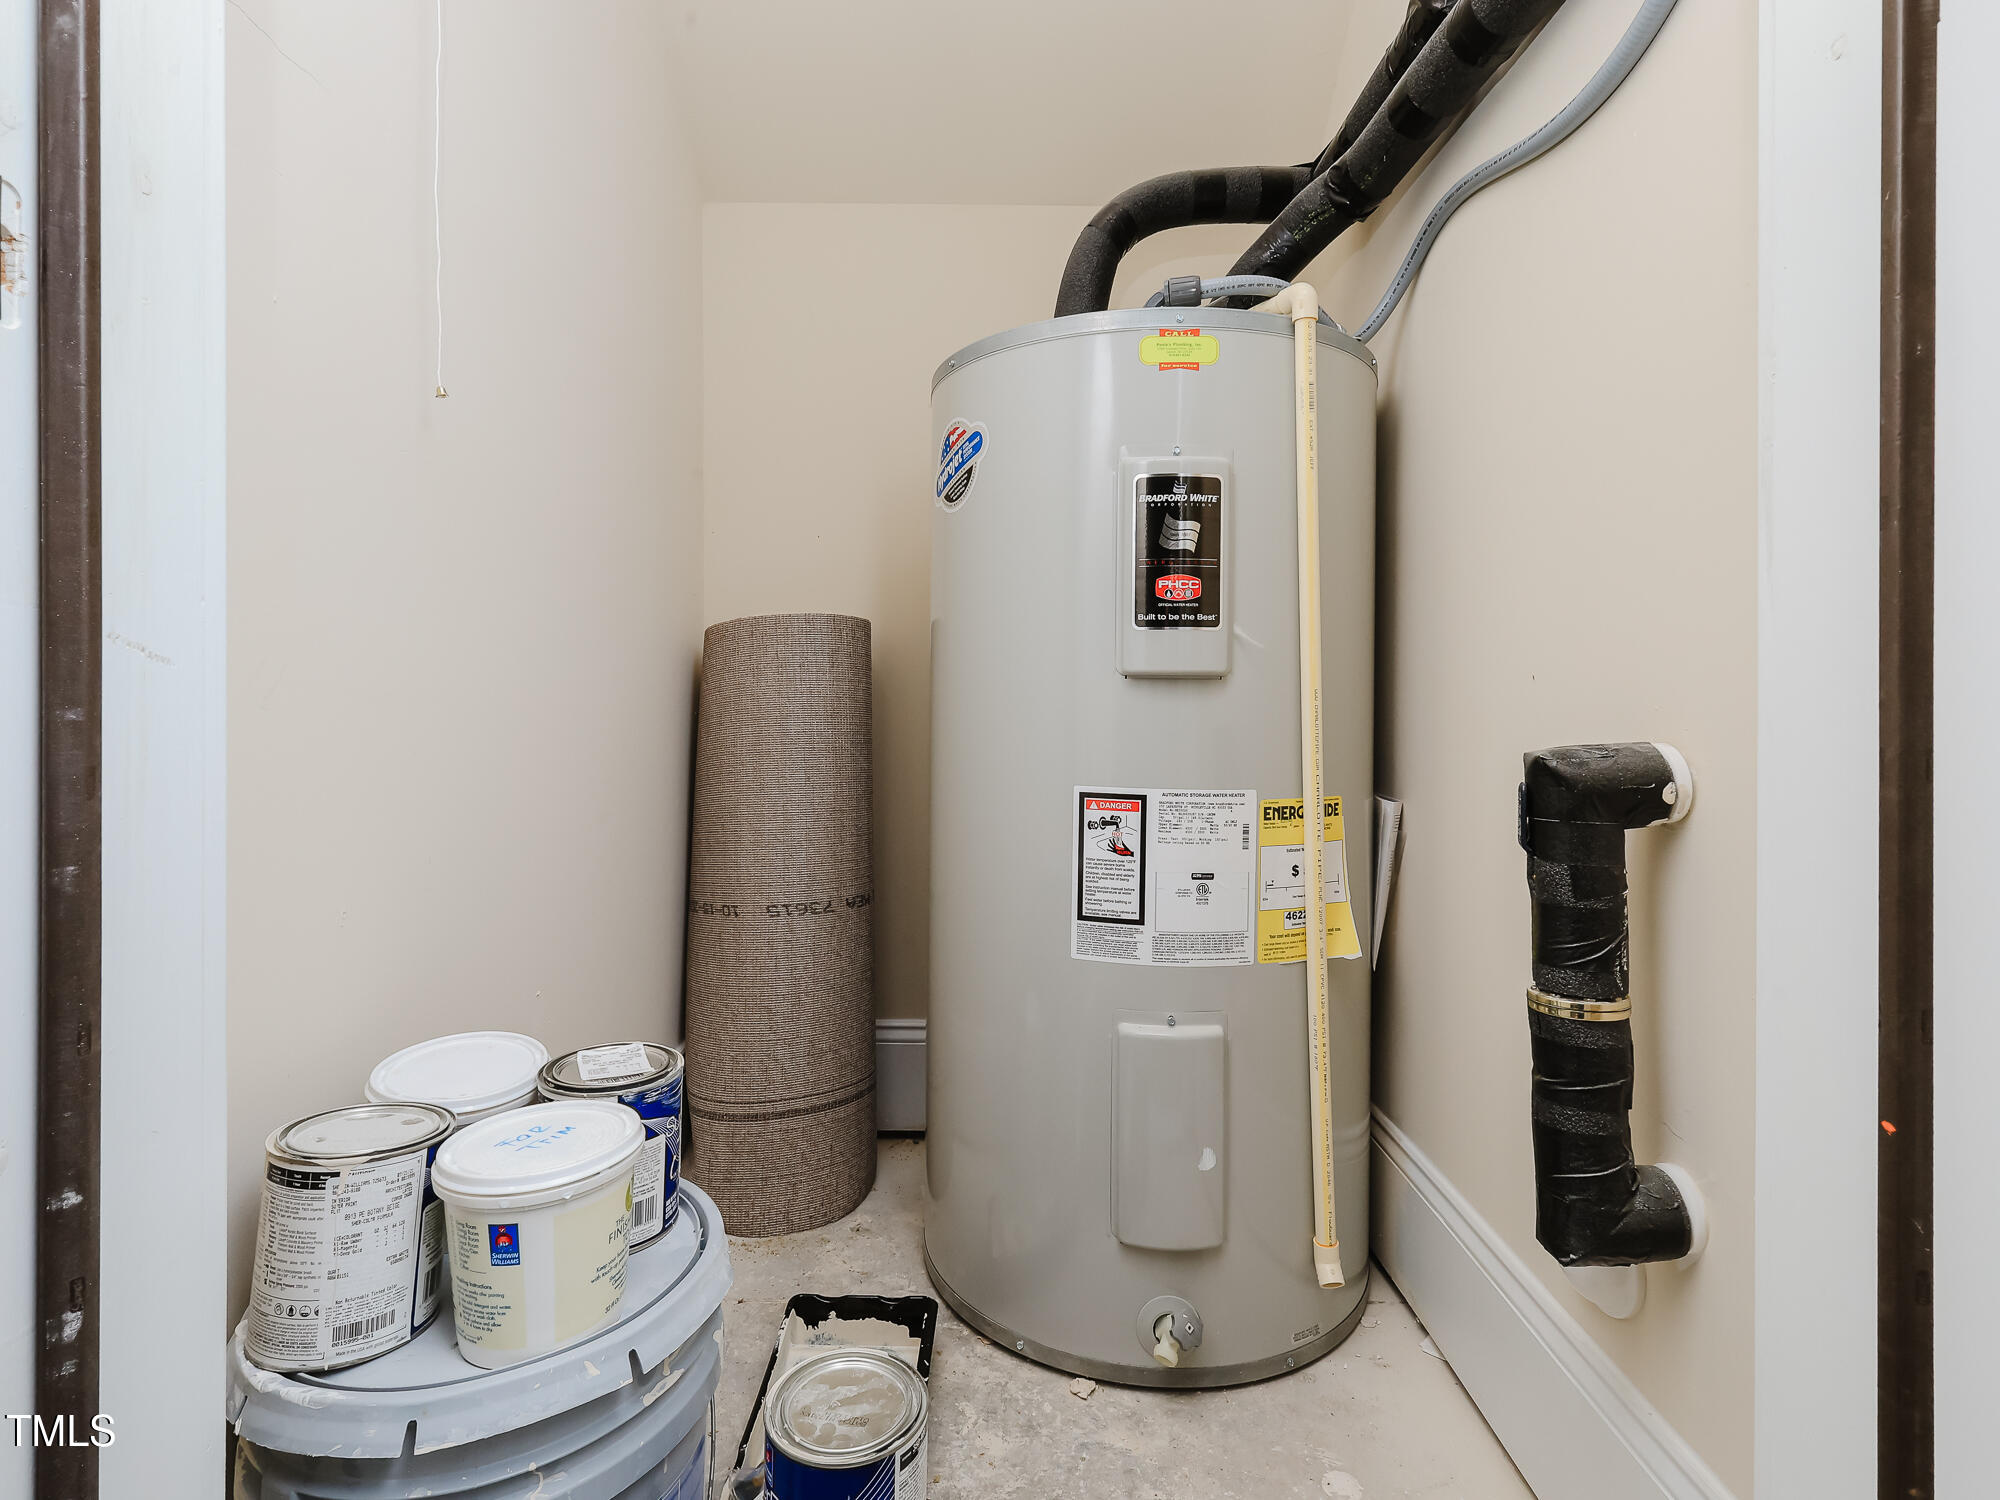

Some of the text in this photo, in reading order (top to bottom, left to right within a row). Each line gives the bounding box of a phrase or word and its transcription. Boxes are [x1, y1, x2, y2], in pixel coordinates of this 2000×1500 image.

[1139, 494, 1218, 503] BRADFORD WHITE
[1158, 580, 1199, 588] PHCC
[1138, 613, 1156, 621] Built
[1168, 613, 1179, 621] be
[1182, 613, 1195, 621] the
[1100, 802, 1132, 810] DANGER
[1291, 865, 1299, 877] $
[332, 1180, 371, 1190] SHEIN-WILLIAMS
[367, 1207, 384, 1216] BOTANY
[386, 1201, 400, 1211] BEIGE
[345, 1293, 369, 1303] Returnable
[371, 1288, 385, 1296] Tinted
[332, 1333, 374, 1348] 0015995-001
